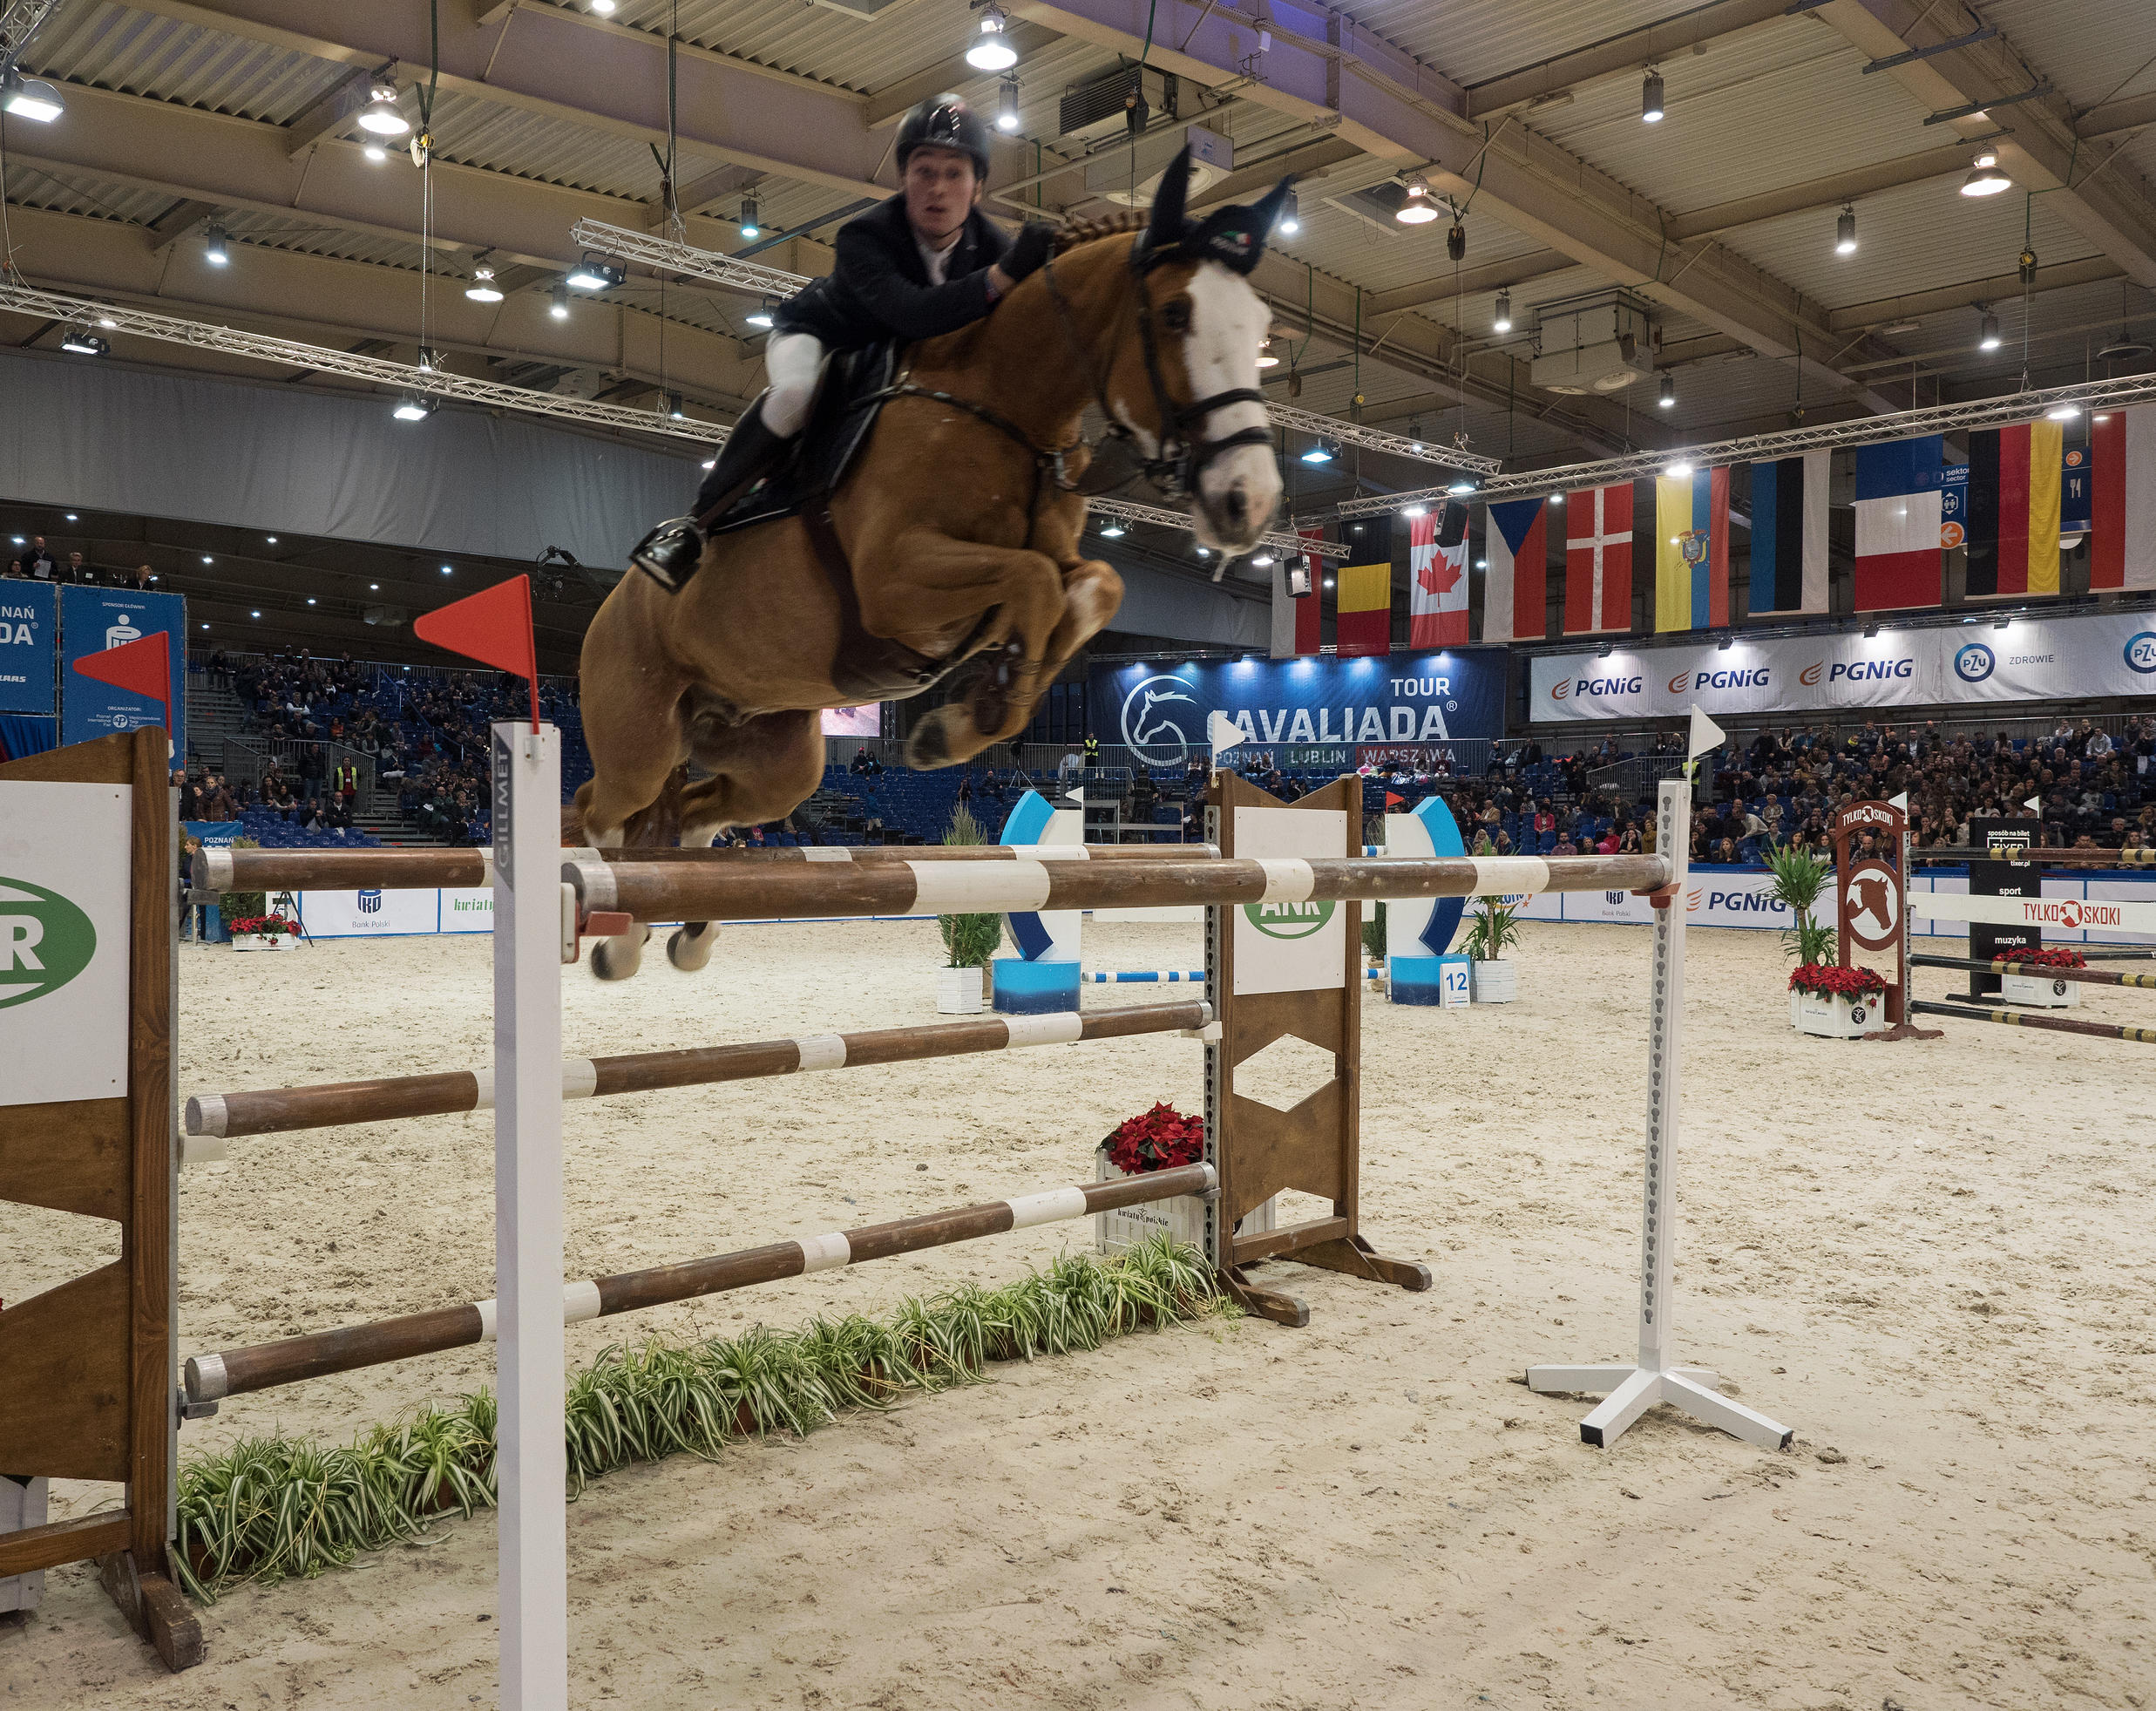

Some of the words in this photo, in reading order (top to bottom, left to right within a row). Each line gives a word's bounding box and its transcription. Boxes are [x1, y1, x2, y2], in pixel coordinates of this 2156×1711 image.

[1828, 658, 1913, 682] PGNiG
[1963, 655, 1986, 671] PZU
[2009, 655, 2055, 665] ZDROWIE
[1390, 677, 1451, 697] TOUR
[1575, 676, 1643, 696] PGNiG
[1695, 668, 1770, 689] PGNiG
[1290, 749, 1346, 764] LUBLIN
[497, 750, 509, 868] GILLMET
[1842, 809, 1862, 827] TYLKO
[1874, 809, 1893, 827] SKOKI
[1987, 829, 2010, 838] sposób
[1999, 886, 2022, 896] sport
[1708, 892, 1787, 913] PGNiG
[371, 920, 390, 928] Polski
[2023, 903, 2059, 921] TYLKO
[2084, 906, 2120, 926] SKOKI
[1995, 935, 2027, 945] muzyka
[1446, 972, 1468, 991] 12
